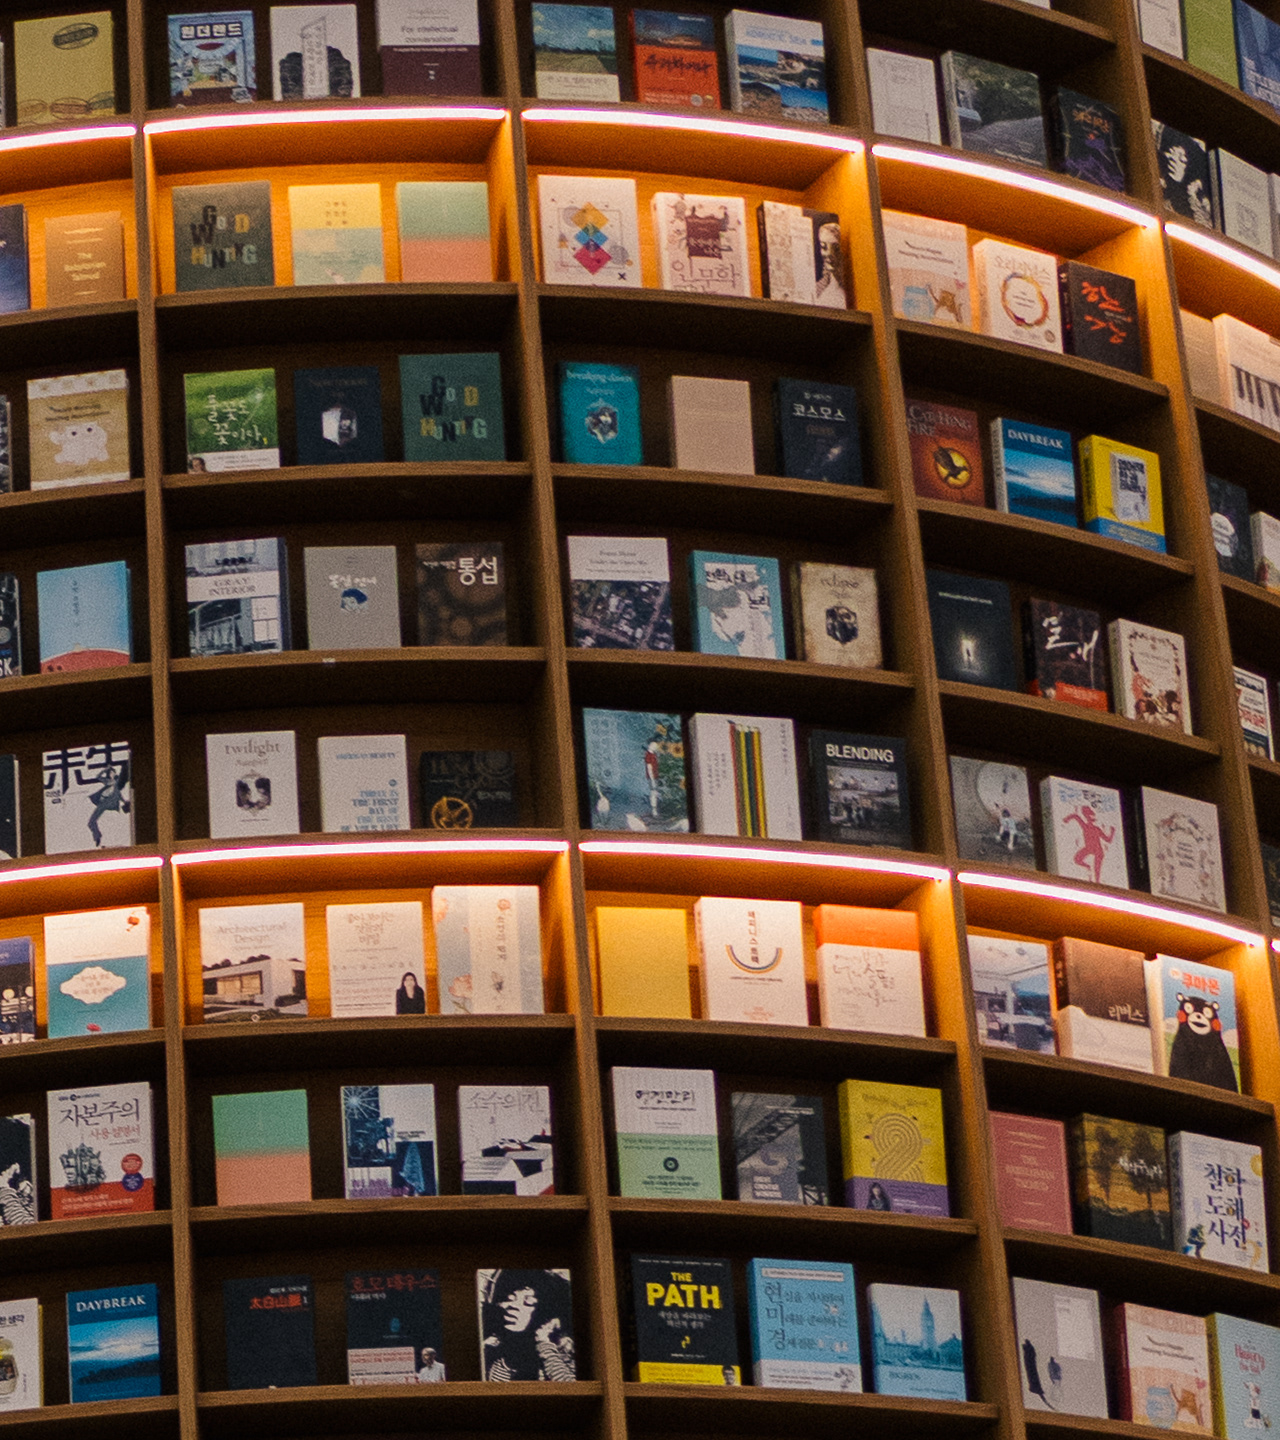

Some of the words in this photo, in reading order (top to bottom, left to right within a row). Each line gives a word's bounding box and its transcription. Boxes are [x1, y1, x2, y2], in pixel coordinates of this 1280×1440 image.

[1008, 426, 1064, 450] DAYBREAK
[457, 556, 500, 588] 통섭
[826, 744, 895, 765] BLENDING
[59, 1096, 140, 1125] 자본주의
[670, 1271, 693, 1284] THE
[75, 1294, 147, 1314] DAYBREAK
[646, 1283, 723, 1311] PATH
